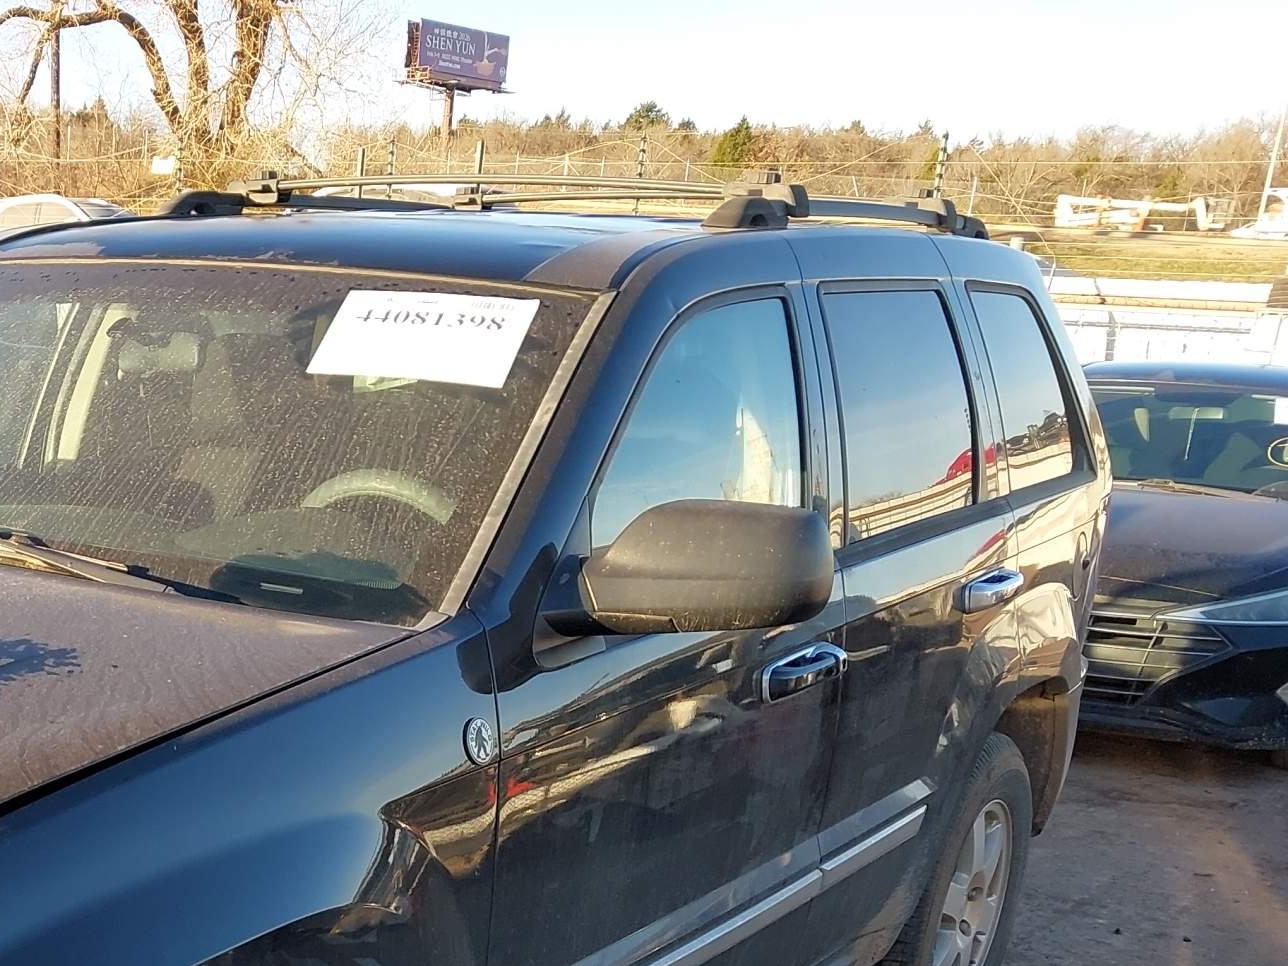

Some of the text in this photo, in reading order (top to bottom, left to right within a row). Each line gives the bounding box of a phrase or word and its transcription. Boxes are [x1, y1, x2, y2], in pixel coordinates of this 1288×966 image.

[425, 34, 476, 56] SHEN YUN
[355, 309, 506, 331] 44081398
